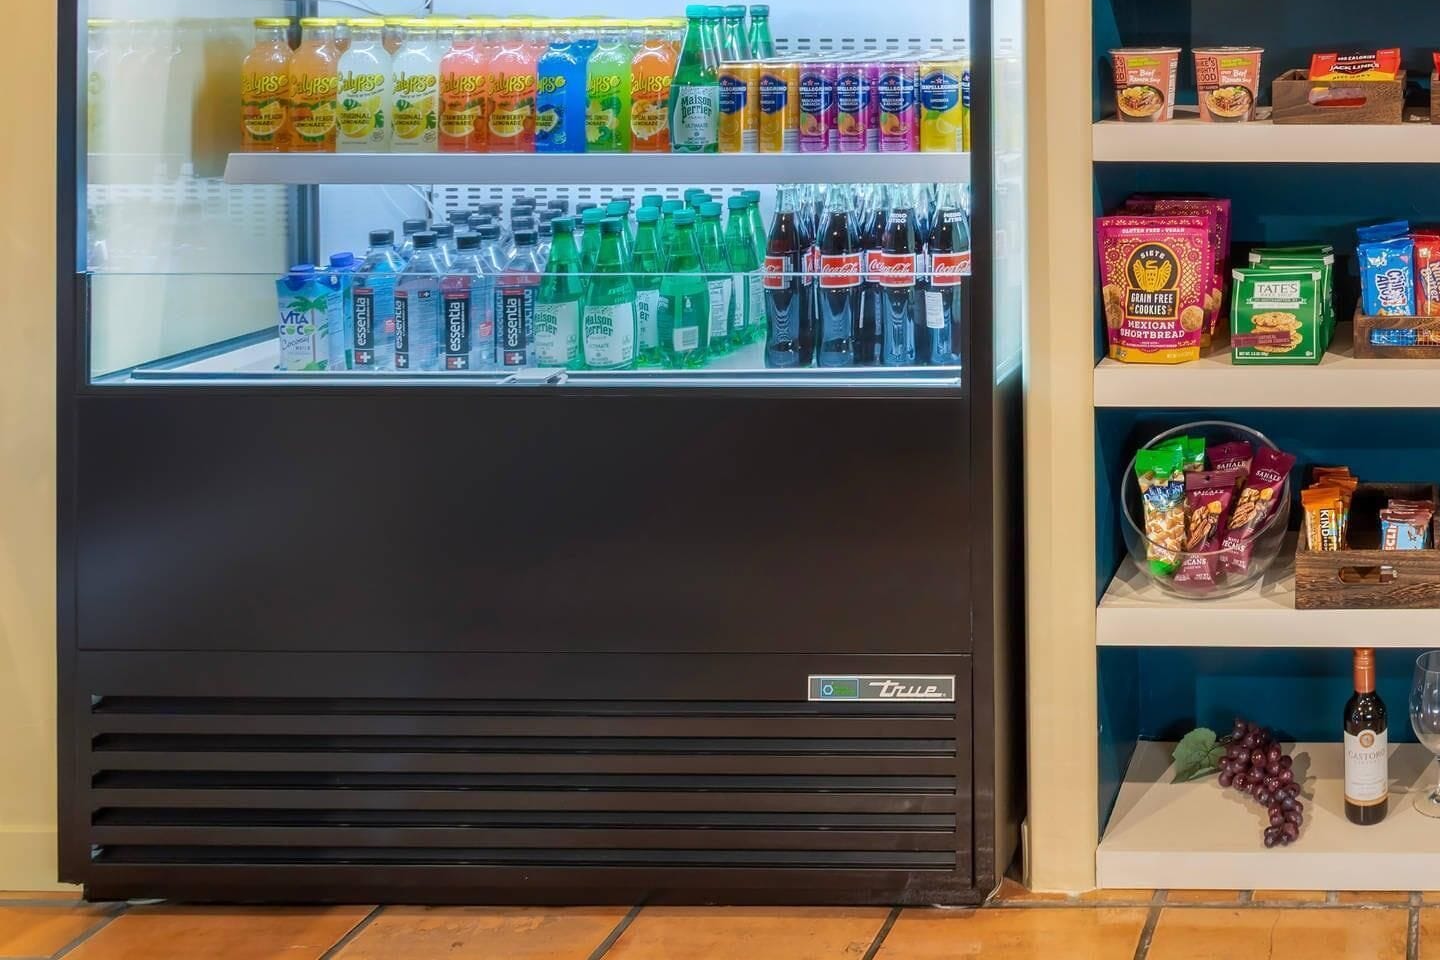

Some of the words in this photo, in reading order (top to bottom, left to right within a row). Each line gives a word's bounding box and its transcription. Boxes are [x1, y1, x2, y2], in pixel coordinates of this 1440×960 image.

[1329, 63, 1351, 72] JACK
[1352, 62, 1380, 70] LINK'S
[681, 96, 712, 107] Maison
[681, 105, 712, 123] Perrier
[1139, 250, 1167, 259] SIETE
[1257, 282, 1298, 294] TATE'S
[1420, 267, 1440, 303] Butter
[1131, 292, 1152, 303] GRAIN
[1154, 292, 1173, 303] FREE
[1134, 305, 1168, 315] COOKIES
[280, 311, 309, 325] VITA
[356, 298, 366, 347] essentia
[505, 298, 517, 347] essentia
[585, 313, 613, 327] Maison
[449, 301, 461, 352] essentia
[1127, 320, 1176, 331] MEXICAN
[584, 324, 614, 343] Perrier
[1119, 329, 1185, 339] SHORTBREAD
[1216, 460, 1246, 470] SAHALE
[1255, 470, 1282, 481] SAHALE
[1319, 508, 1329, 536] KIND
[1185, 557, 1208, 566] CANS
[1346, 749, 1386, 761] CASTORO
